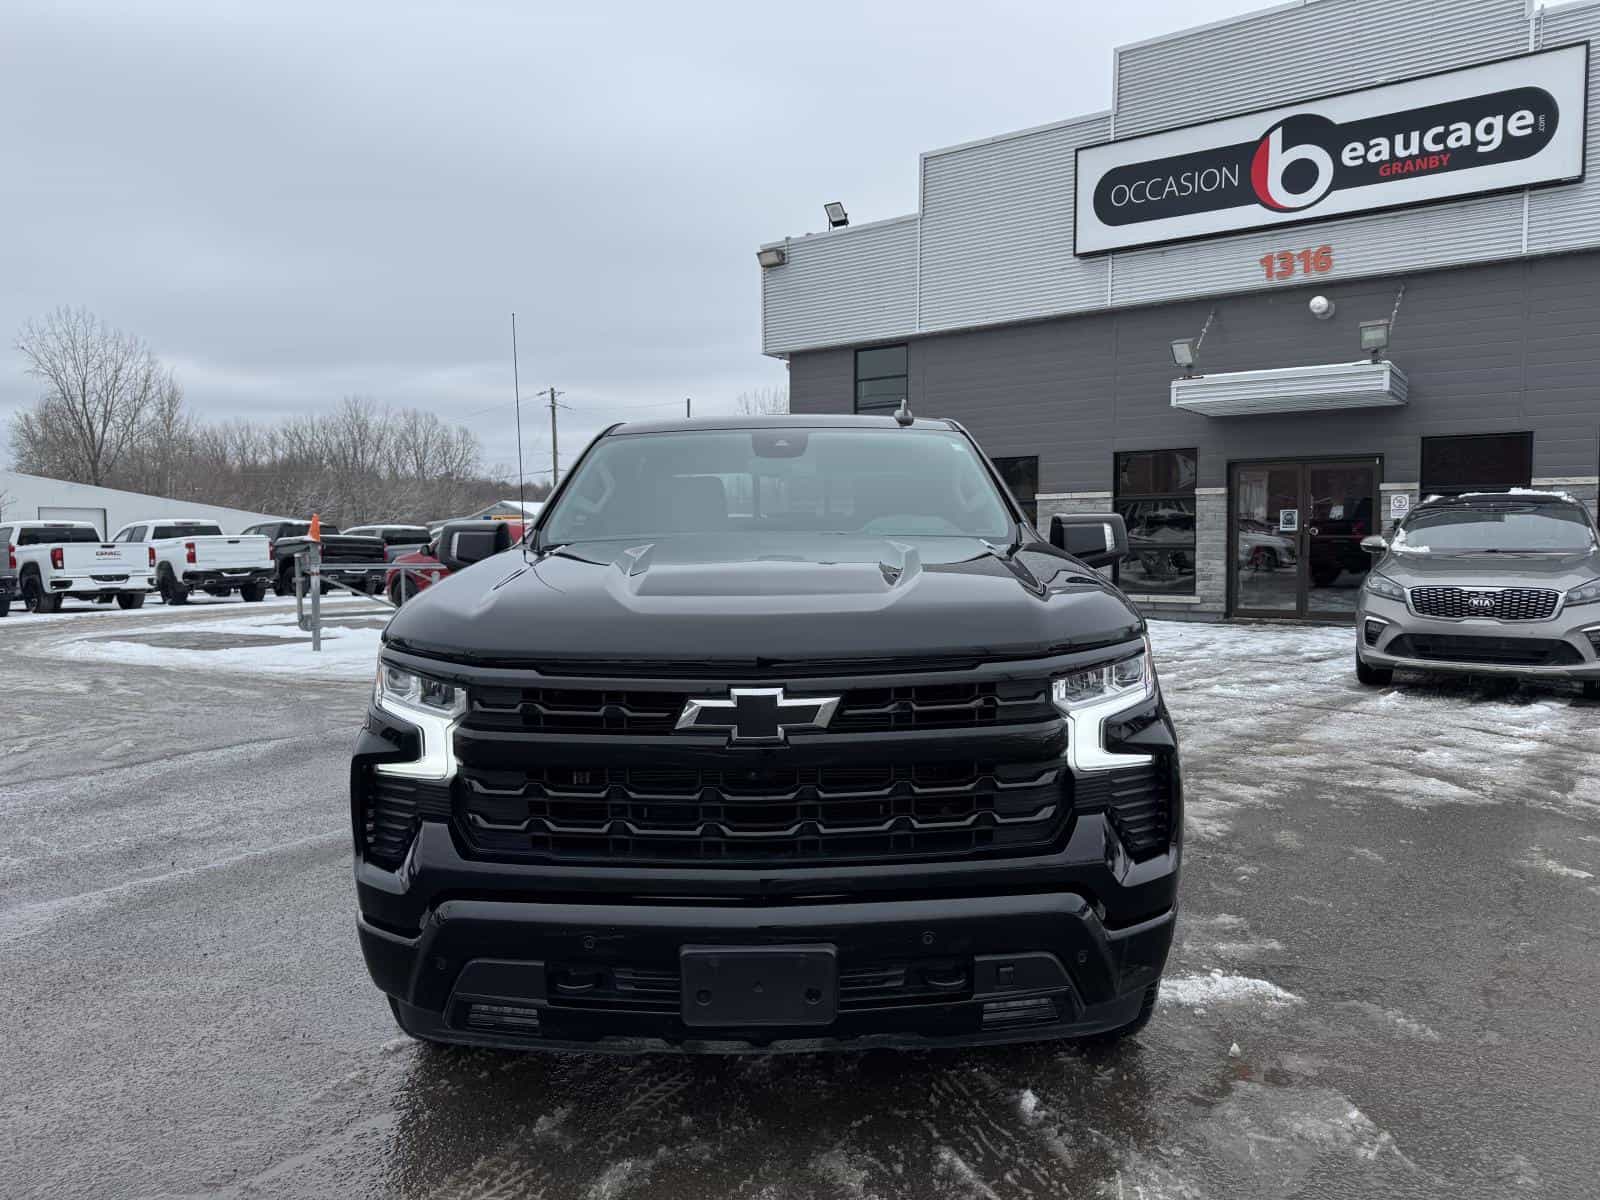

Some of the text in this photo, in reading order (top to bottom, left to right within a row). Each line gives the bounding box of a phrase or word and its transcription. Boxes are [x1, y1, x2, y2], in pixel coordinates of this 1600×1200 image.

[1378, 153, 1451, 178] GRANBY
[1110, 165, 1239, 207] OCCASION
[1260, 245, 1333, 280] 1316
